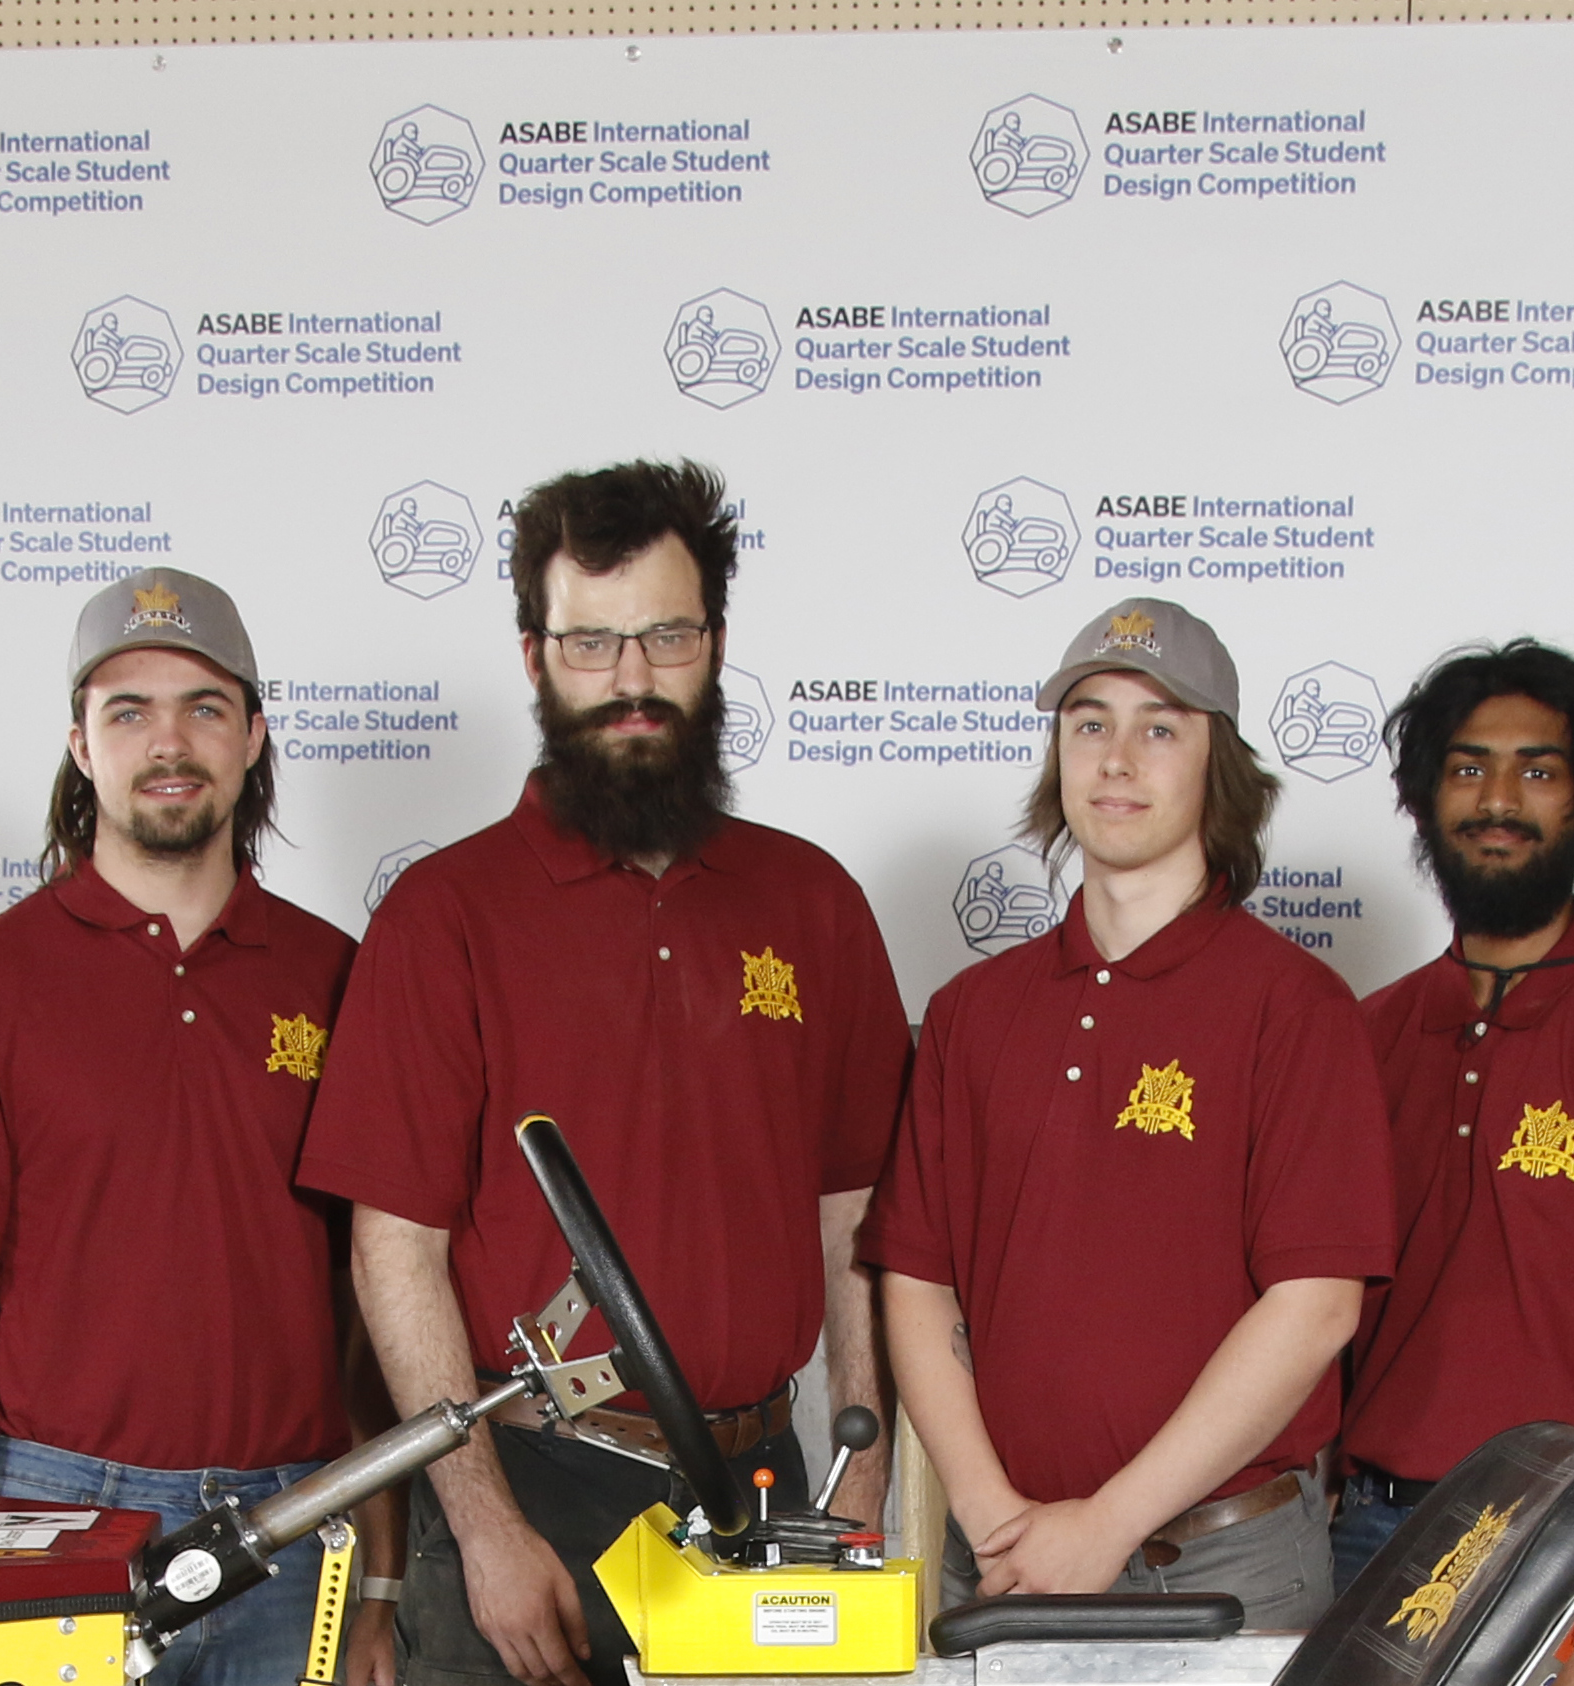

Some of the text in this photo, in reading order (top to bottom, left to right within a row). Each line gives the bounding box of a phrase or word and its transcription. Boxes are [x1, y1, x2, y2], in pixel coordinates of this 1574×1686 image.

[499, 119, 749, 145] ASABE International
[1104, 109, 1365, 135] ASABE International
[0, 129, 150, 153] International
[499, 149, 770, 177] Quarter Scale Student
[1104, 140, 1386, 168] Quarter Scale Student
[5, 160, 71, 183] Scale
[76, 159, 170, 182] Student
[499, 180, 742, 209] Design Competition
[1104, 172, 1356, 201] Design Competition
[197, 310, 441, 335] ASABE International
[795, 304, 1050, 329] ASABE International
[1416, 299, 1510, 323] ASABE
[197, 341, 461, 368] Quarter Scale Student
[795, 335, 1070, 362] Quarter Scale Student
[1416, 331, 1517, 357] Quarter
[197, 371, 434, 399] Design Competition
[795, 365, 1041, 394] Design Competition
[1416, 362, 1504, 389] Design
[3, 501, 151, 523] International
[1095, 495, 1354, 518] ASABE International
[9, 531, 73, 553] Scale
[78, 531, 171, 552] Student
[1095, 525, 1374, 551] Quarter Scale Student
[1095, 556, 1344, 584] Design Competition
[288, 680, 439, 701] International
[789, 680, 877, 701] ASABE
[294, 709, 359, 731] Scale
[365, 709, 458, 731] Student
[788, 710, 1052, 734] Quarter Scale Studen
[284, 738, 431, 763] Competition
[788, 740, 1032, 766] Design Competition
[1262, 896, 1363, 918] Student
[770, 1595, 830, 1605] CAUTION
